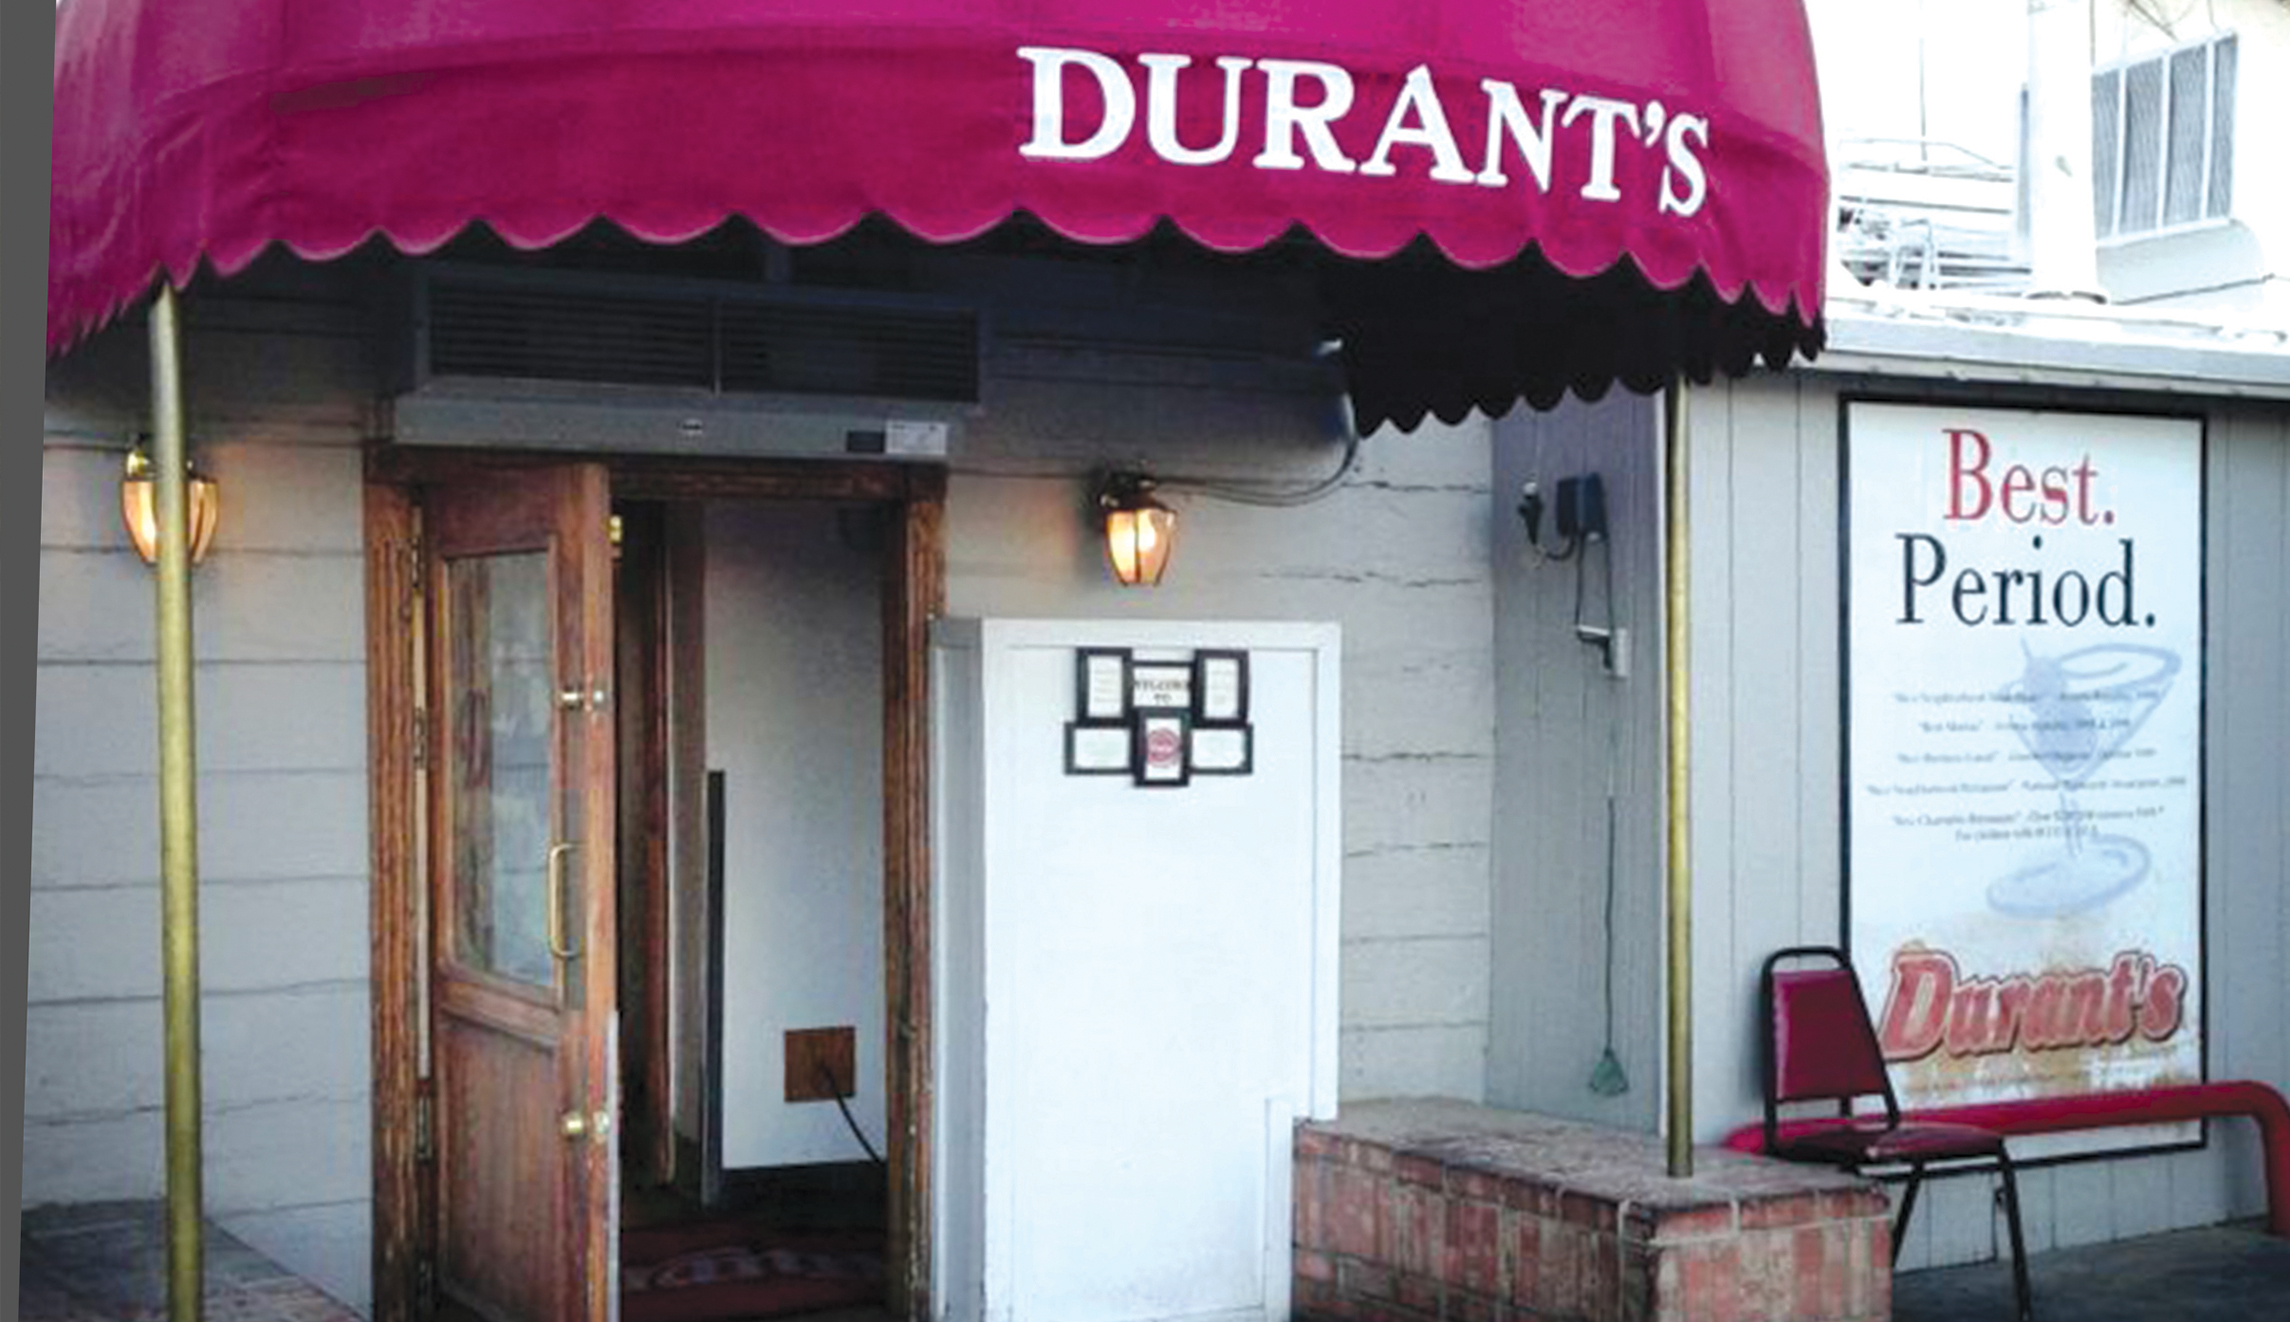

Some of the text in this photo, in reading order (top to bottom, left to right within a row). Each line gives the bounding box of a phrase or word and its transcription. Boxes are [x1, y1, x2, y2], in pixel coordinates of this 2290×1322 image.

[1017, 46, 1709, 217] DURANT'S
[1942, 428, 2115, 525] Best.
[1895, 532, 2156, 627] Period.
[1880, 950, 2187, 1063] Durant's
